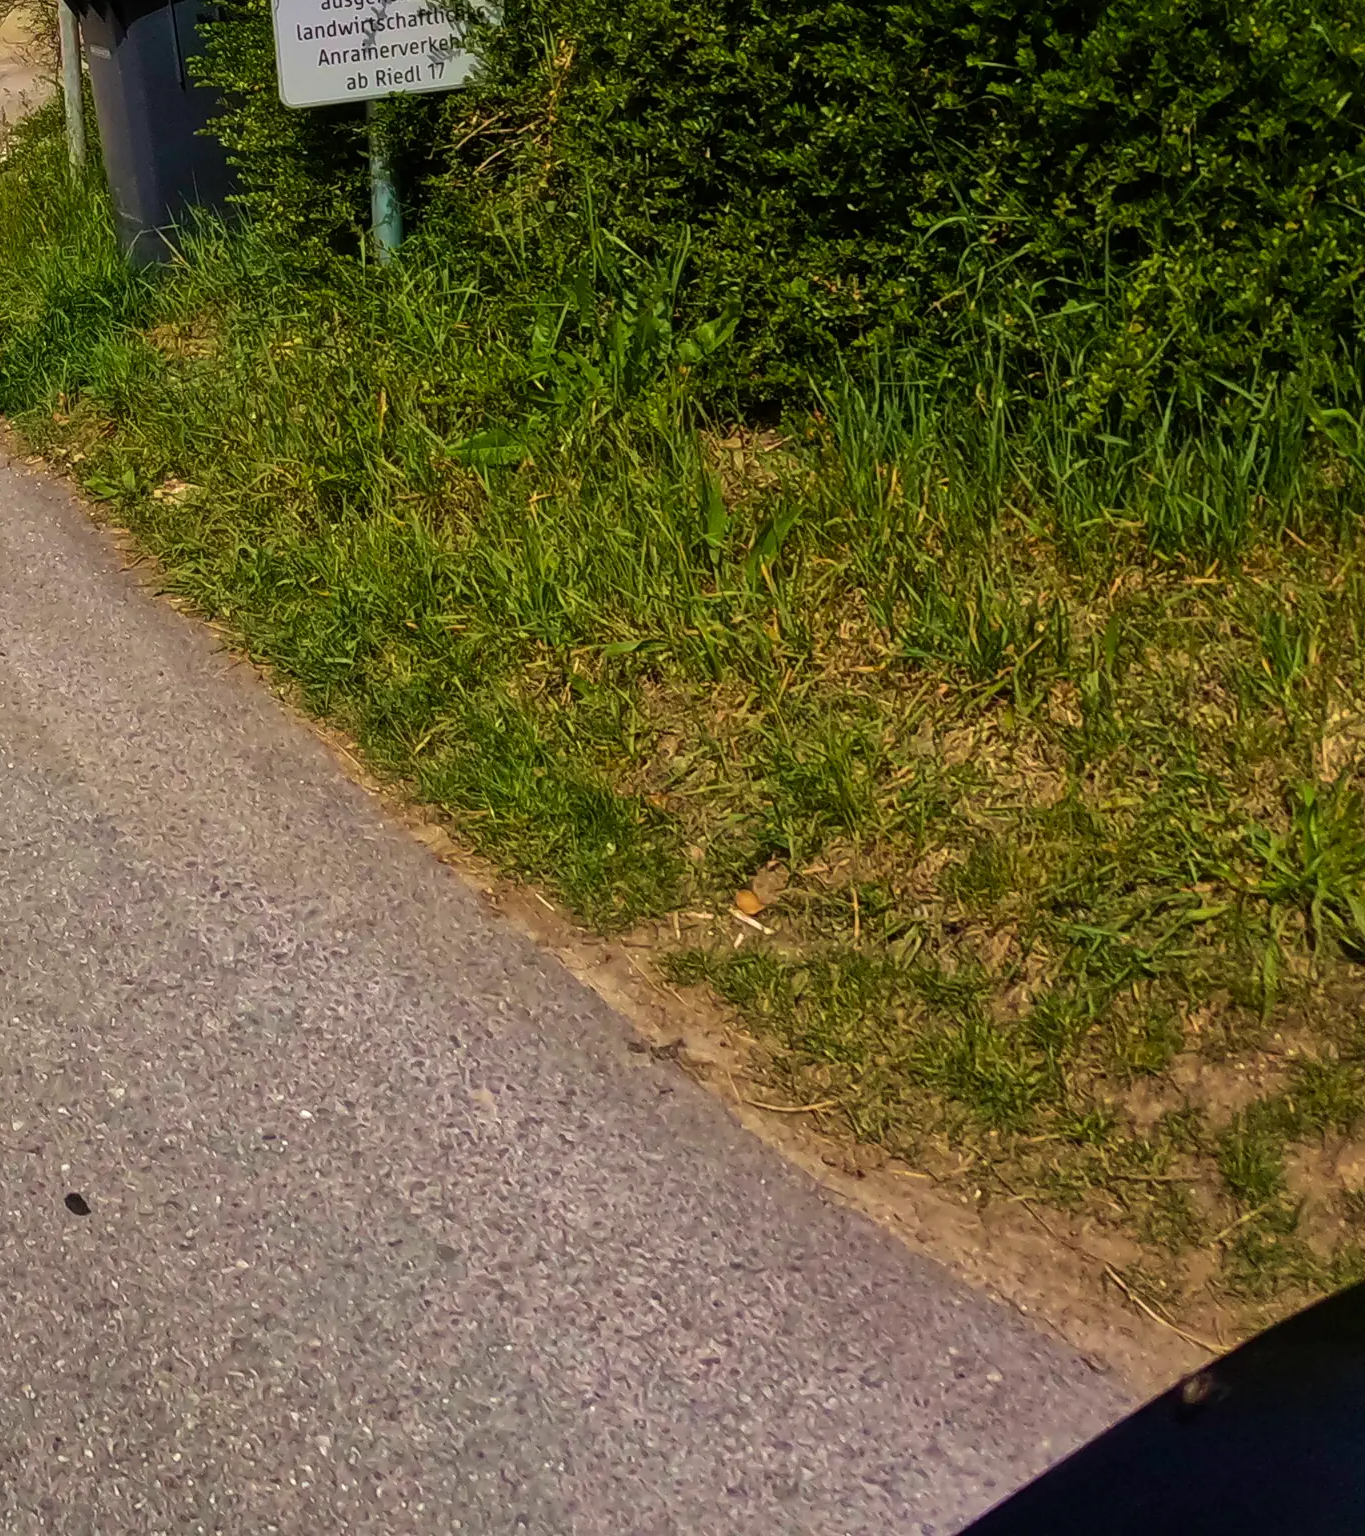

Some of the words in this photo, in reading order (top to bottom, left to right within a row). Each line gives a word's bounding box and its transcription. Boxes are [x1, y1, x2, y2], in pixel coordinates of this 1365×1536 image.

[318, 32, 471, 67] Anrainerverkeh
[346, 73, 368, 91] ab
[375, 65, 422, 87] Riedl
[427, 62, 445, 80] 17
